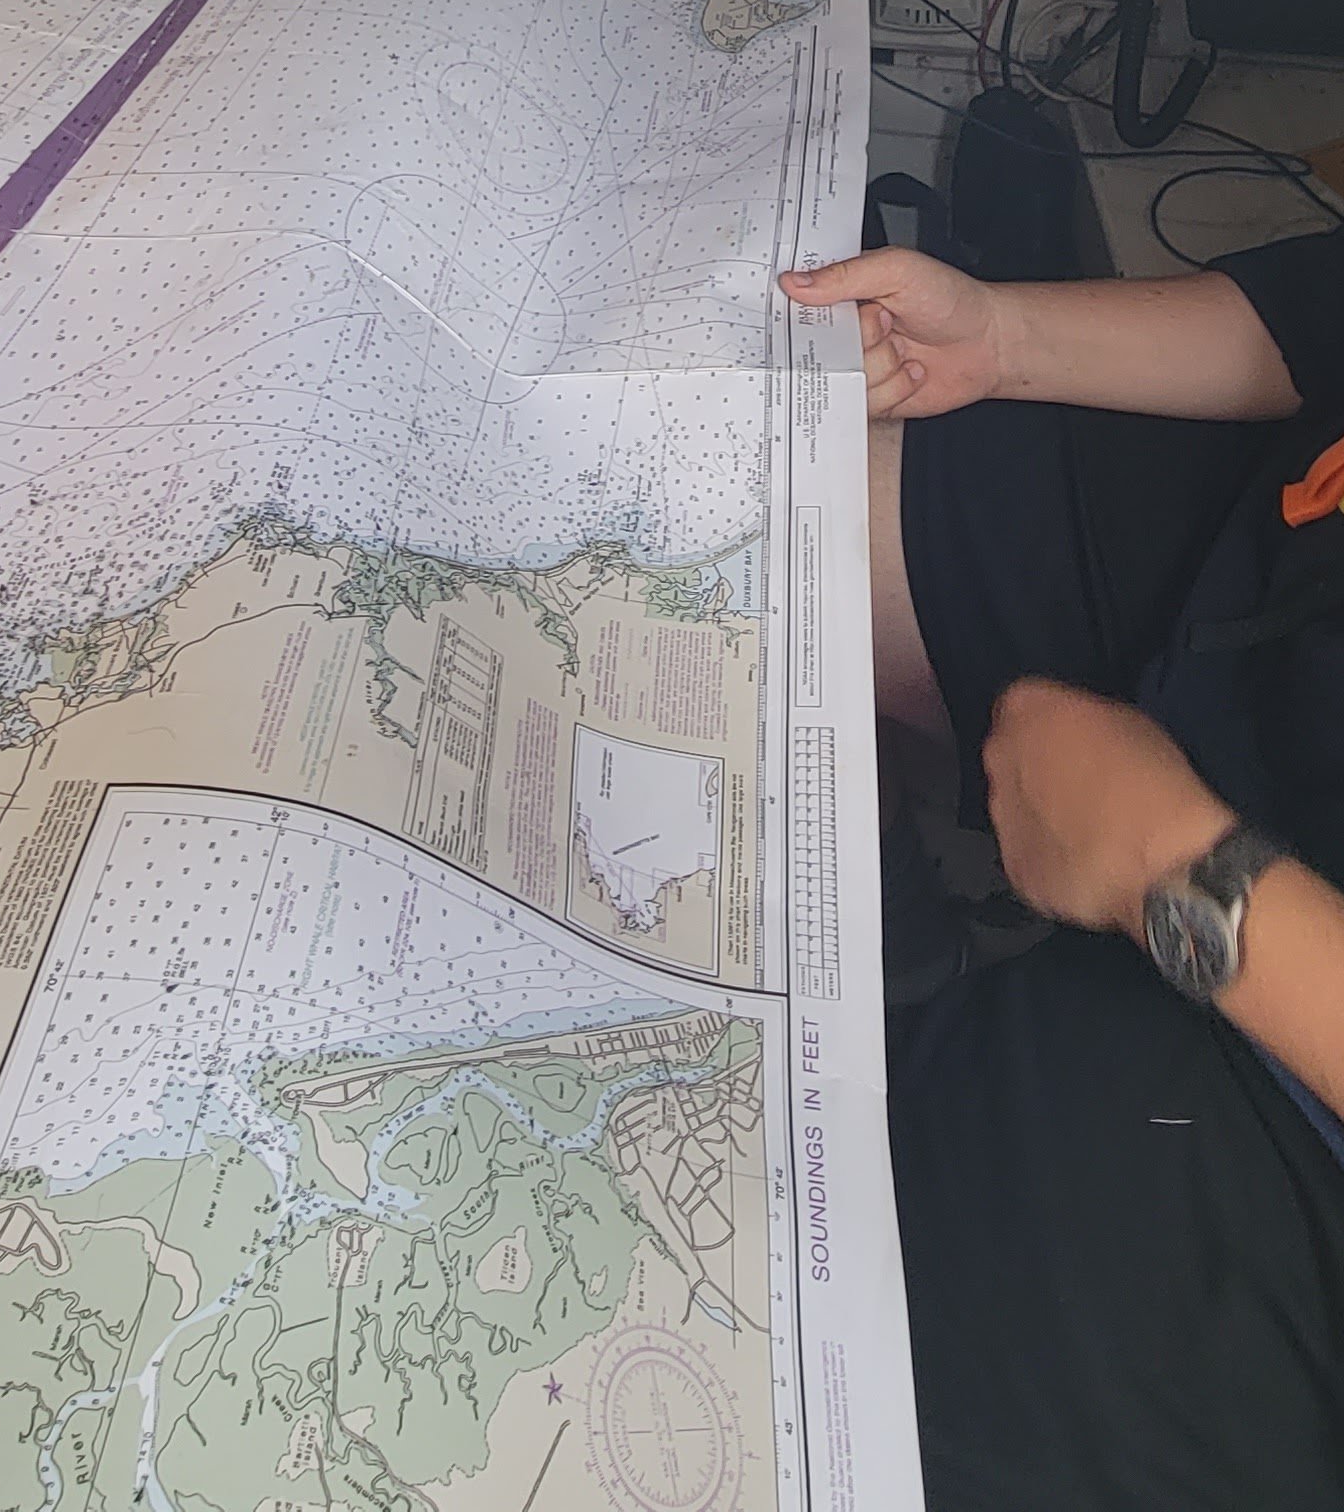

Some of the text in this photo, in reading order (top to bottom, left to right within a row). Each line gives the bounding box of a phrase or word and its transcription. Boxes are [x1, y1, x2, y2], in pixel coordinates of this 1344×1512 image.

[743, 549, 753, 608] DUXBURY BAY
[801, 1015, 831, 1283] SOUNDINGS IN FEET
[463, 1188, 494, 1221] South
